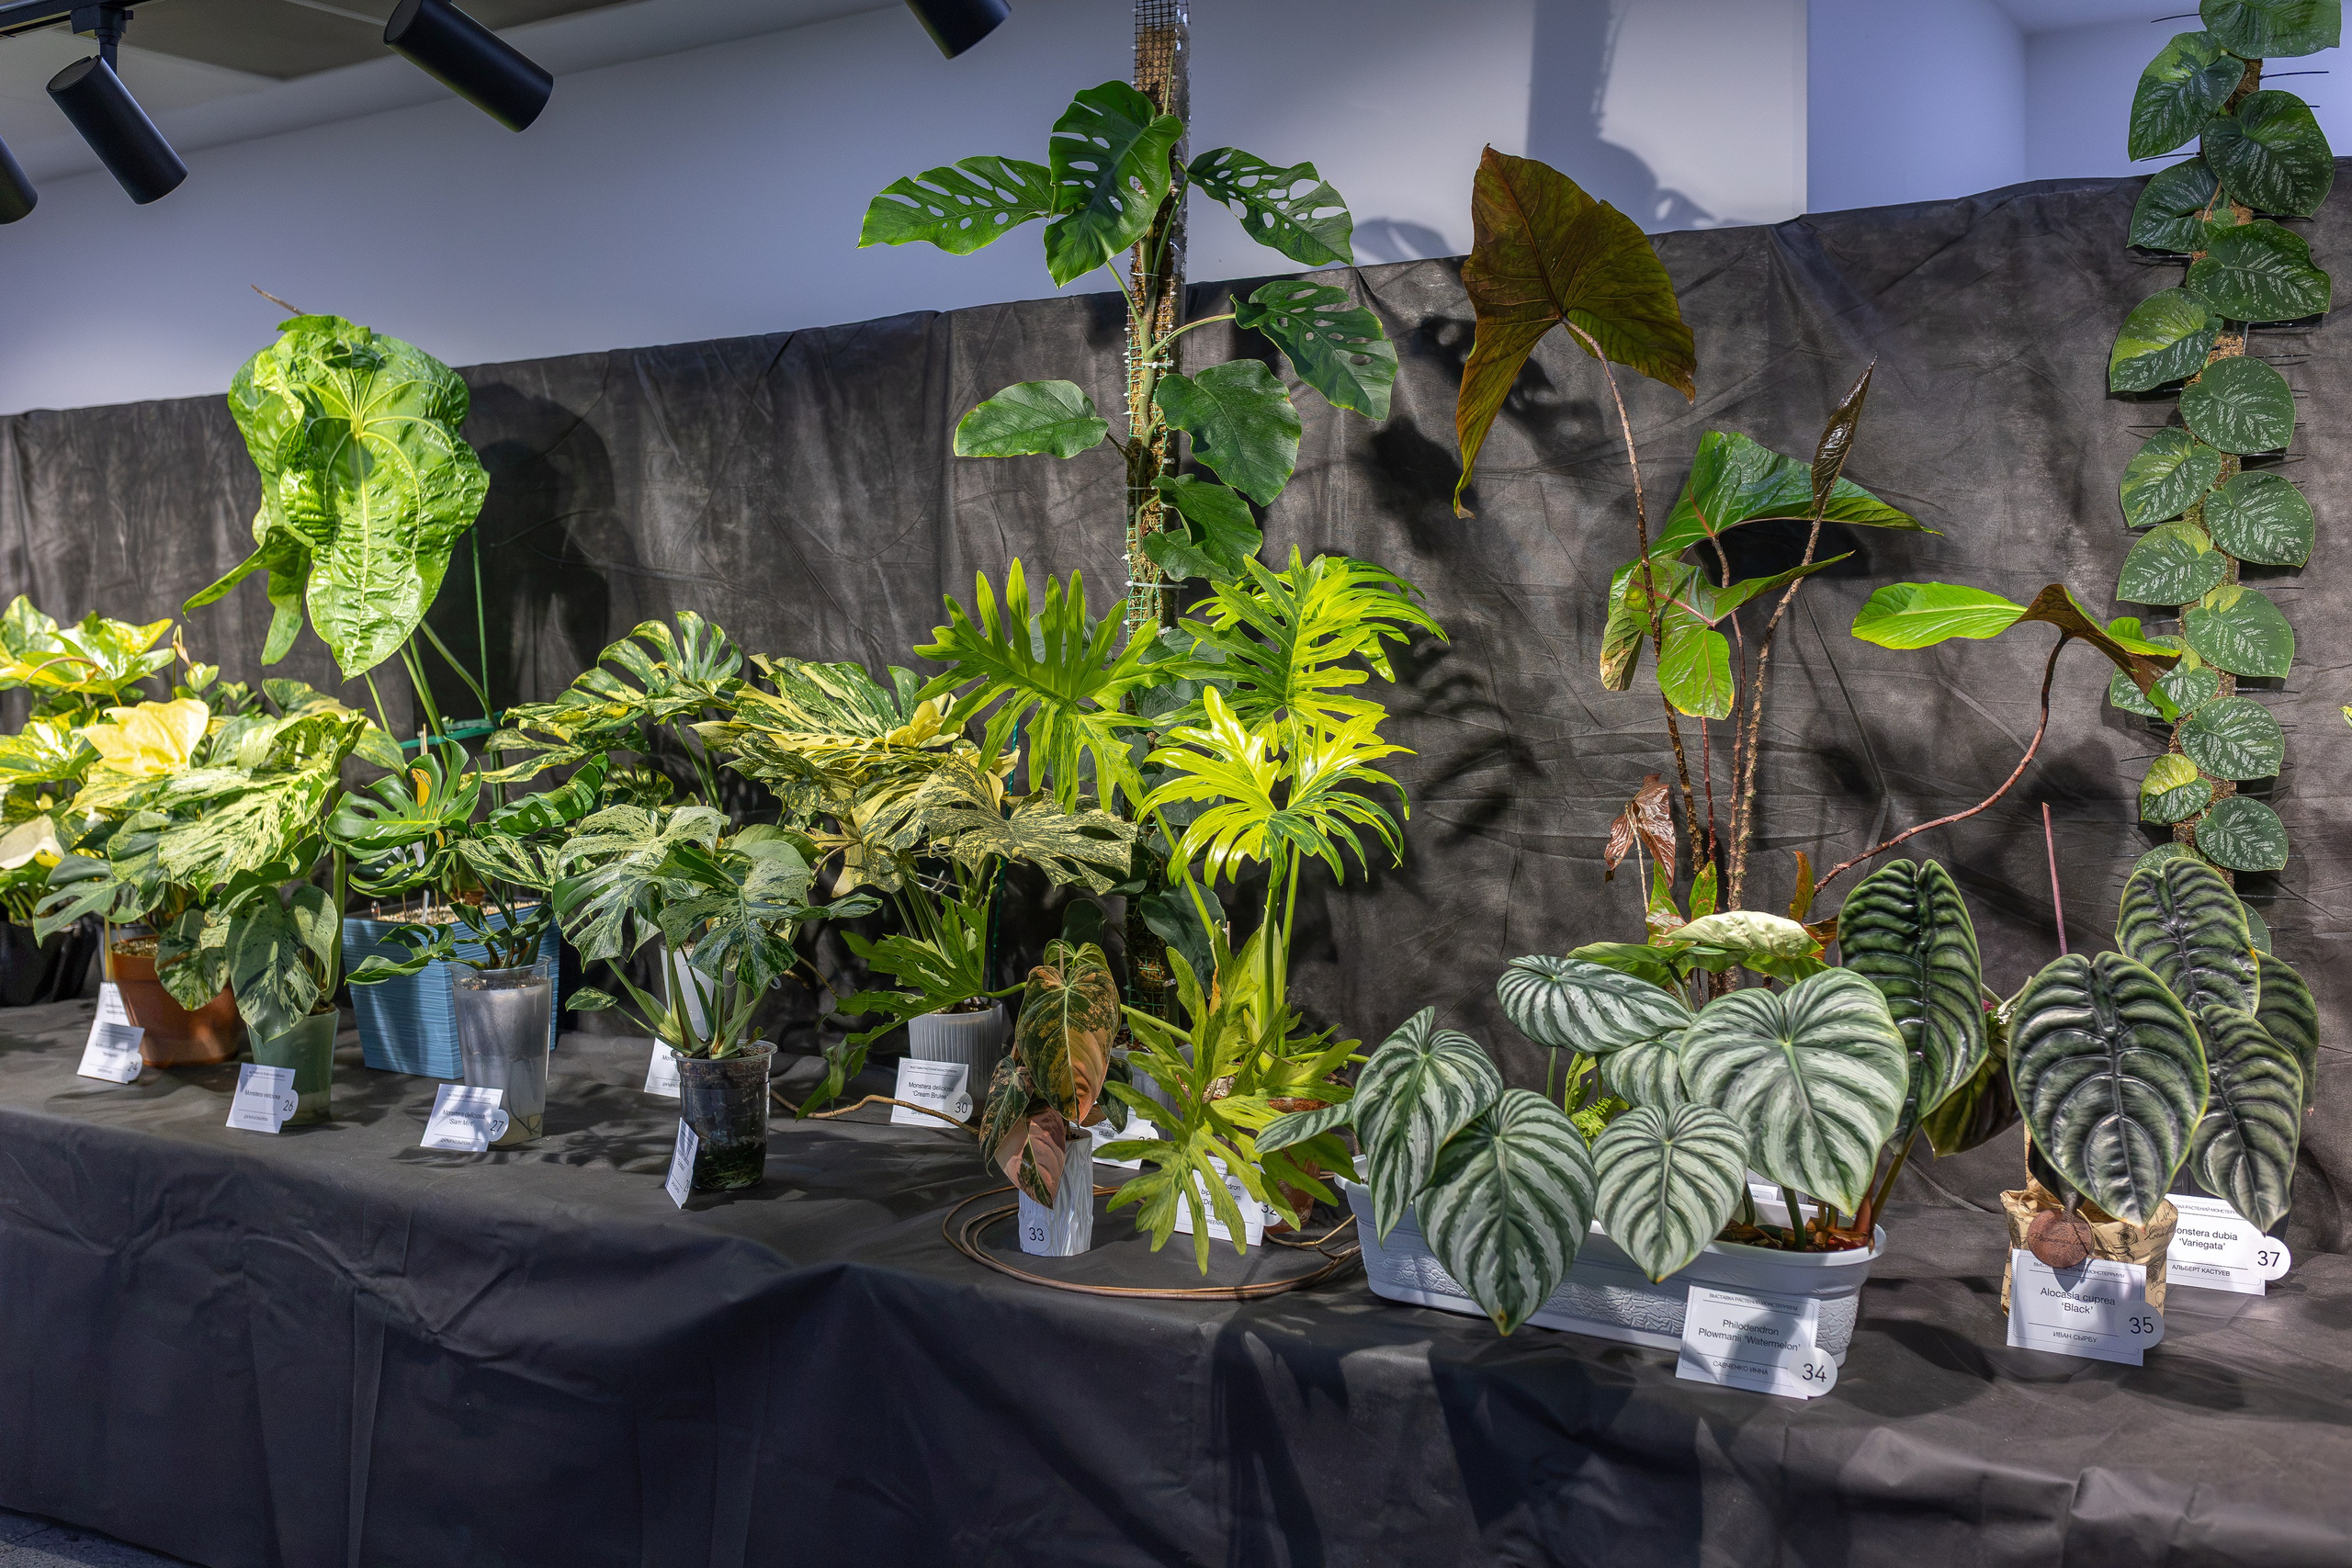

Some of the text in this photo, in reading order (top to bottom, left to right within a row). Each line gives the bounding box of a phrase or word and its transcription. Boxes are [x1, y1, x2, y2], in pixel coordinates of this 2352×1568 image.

[908, 1081, 932, 1090] Monstera
[283, 1100, 294, 1111] 26
[955, 1101, 968, 1114] 30
[490, 1120, 504, 1133] 27
[1028, 1226, 1045, 1242] 33
[2174, 1226, 2238, 1241] onstera dubia
[2256, 1250, 2281, 1268] 37
[2171, 1264, 2231, 1277] АЛЬБЕРТ КАСТУЕВ
[2040, 1287, 2116, 1306] Alocasia cuprea
[1722, 1319, 1780, 1337] Philodendron
[2129, 1316, 2154, 1335] 35
[1698, 1327, 1742, 1343] Plowmanii
[2052, 1331, 2098, 1344] ИВАН СЫРБУ
[1713, 1360, 1749, 1372] САВЧЕНКО
[1802, 1363, 1827, 1383] 34
